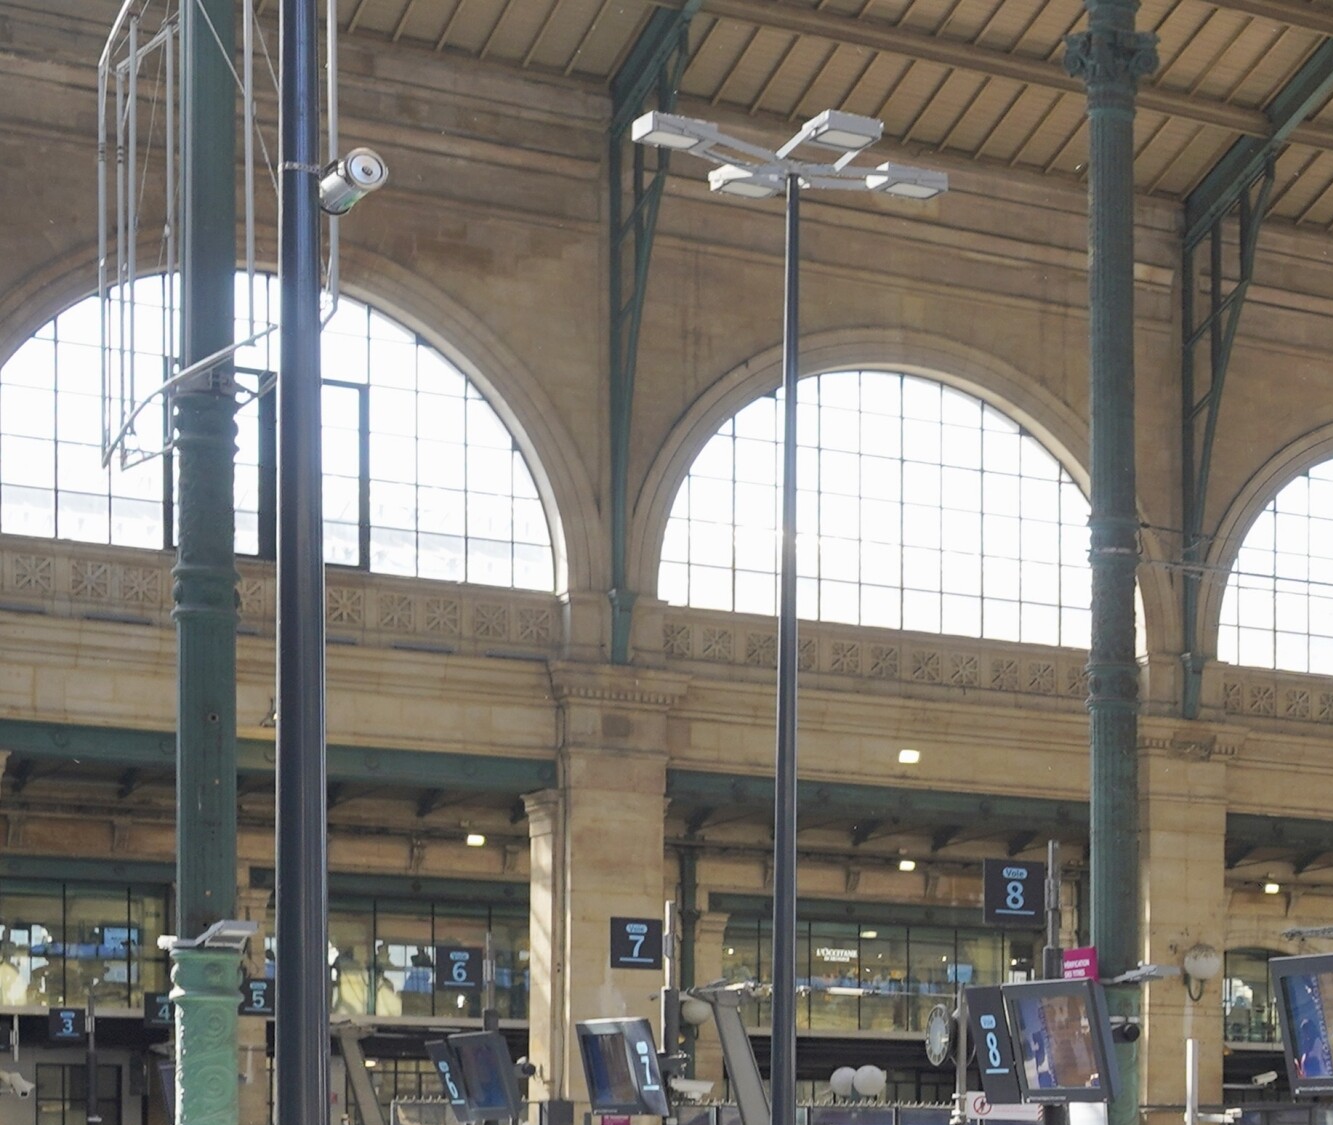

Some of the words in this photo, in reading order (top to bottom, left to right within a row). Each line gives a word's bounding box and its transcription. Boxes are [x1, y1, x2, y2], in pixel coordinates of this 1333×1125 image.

[1005, 869, 1025, 878] Voie
[1006, 881, 1024, 909] 8
[629, 935, 645, 957] 7
[452, 962, 467, 982] 6
[252, 990, 265, 1008] 5
[159, 1004, 170, 1020] 4
[62, 1019, 73, 1034] 3
[986, 1032, 1001, 1067] 8
[640, 1055, 651, 1085] 7
[445, 1072, 459, 1099] 6
